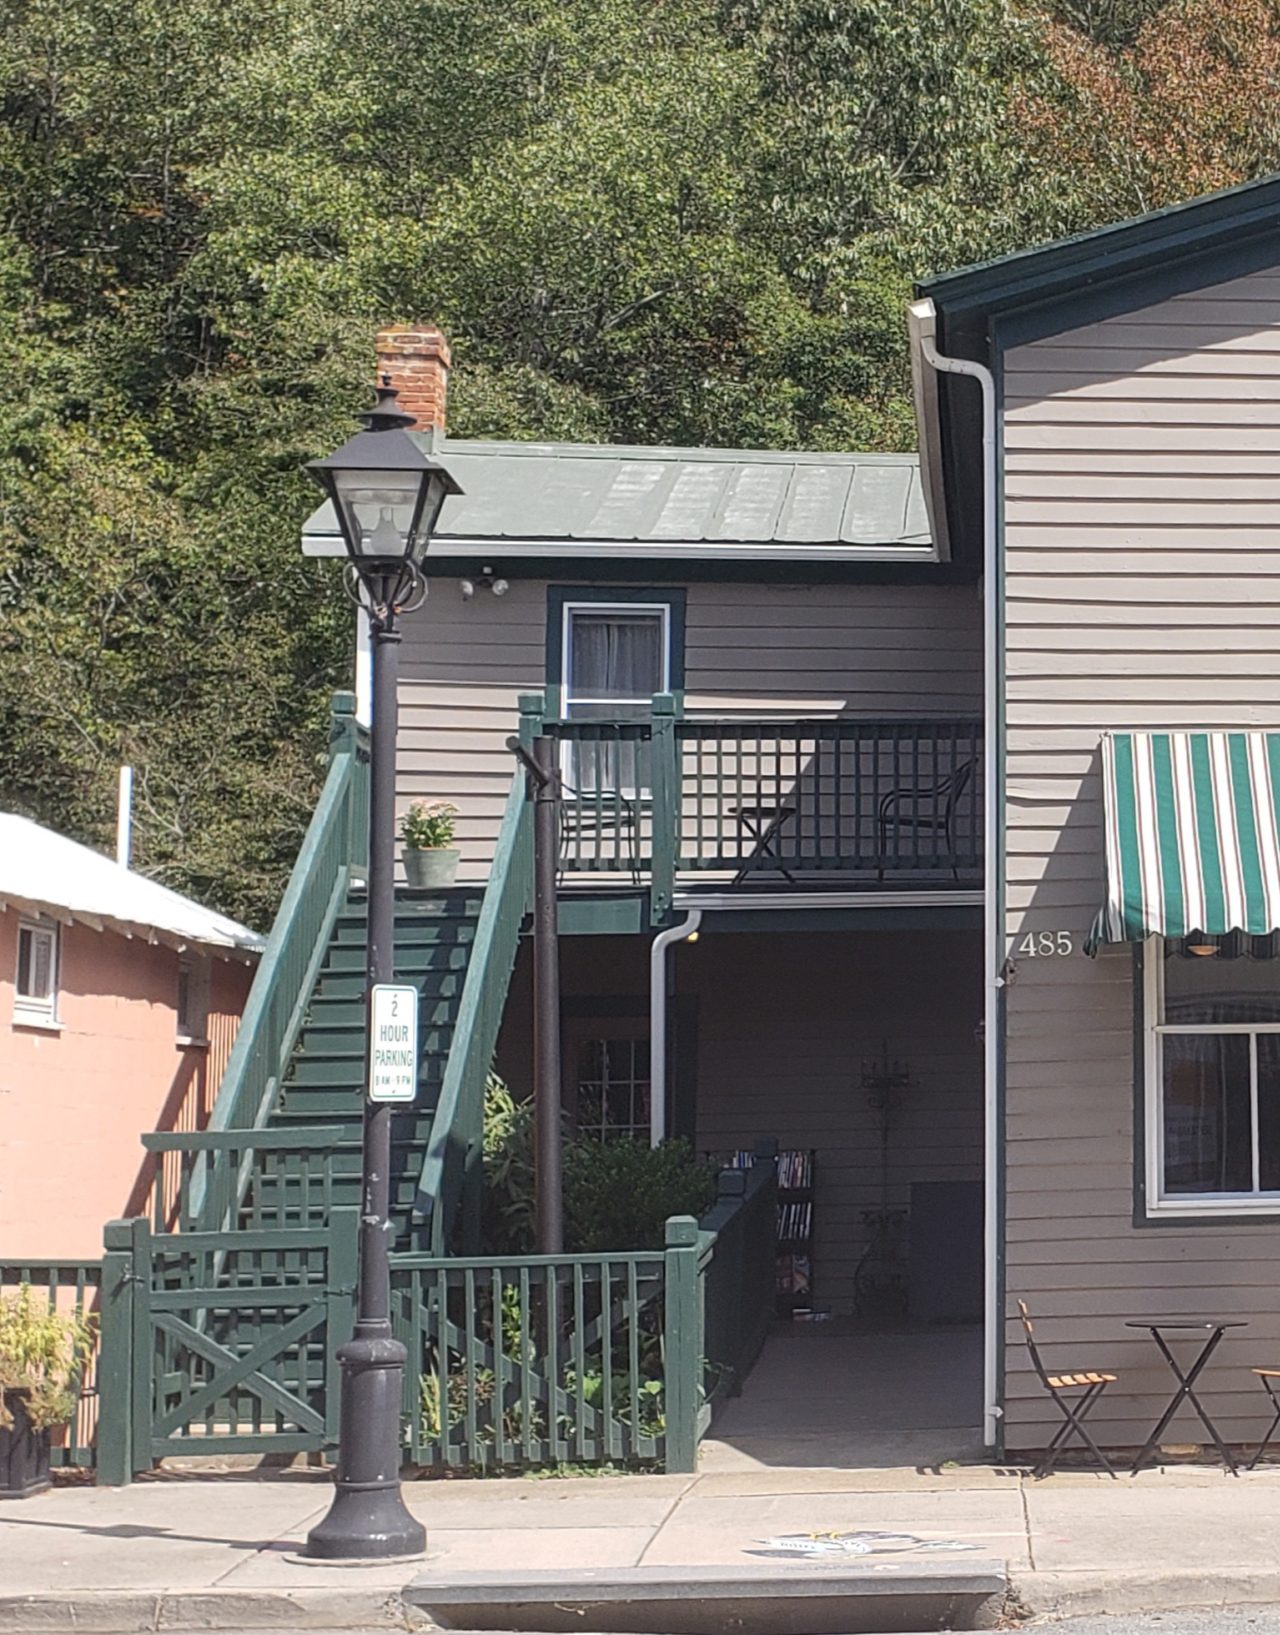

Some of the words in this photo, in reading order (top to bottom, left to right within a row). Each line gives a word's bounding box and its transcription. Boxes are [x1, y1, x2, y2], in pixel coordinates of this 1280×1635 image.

[1018, 930, 1073, 957] 485
[391, 1000, 398, 1017] 2
[380, 1025, 409, 1042] HOUR
[374, 1050, 413, 1067] PARKING
